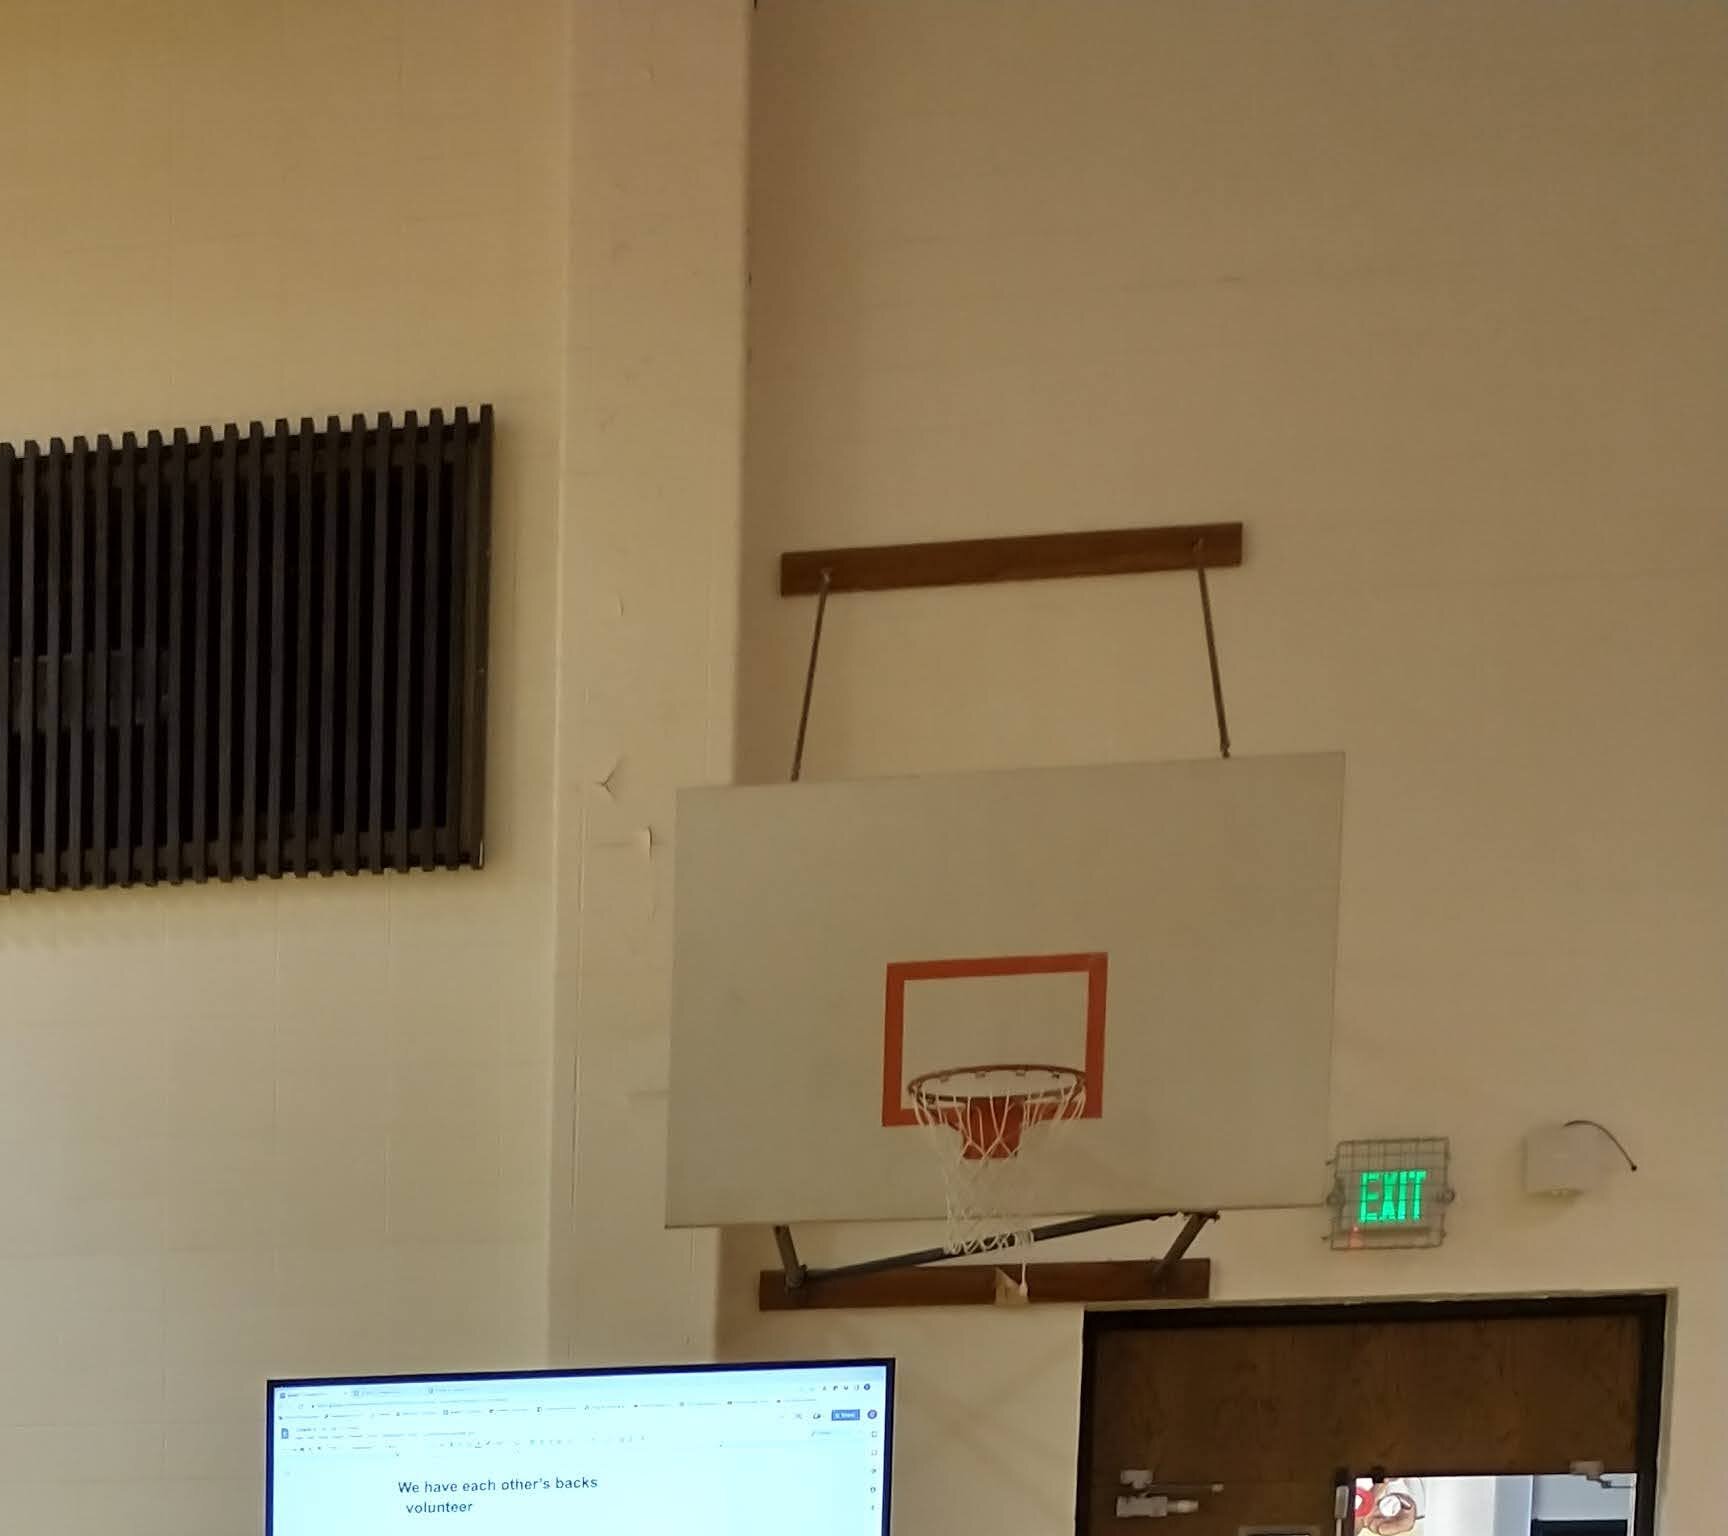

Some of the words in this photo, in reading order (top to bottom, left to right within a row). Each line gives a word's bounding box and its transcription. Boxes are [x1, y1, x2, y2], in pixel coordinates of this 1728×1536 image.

[1358, 1169, 1427, 1224] EXIT
[398, 1482, 419, 1493] We
[425, 1481, 457, 1493] have
[463, 1480, 495, 1491] each
[502, 1478, 550, 1490] other's
[556, 1477, 597, 1488] backs
[406, 1501, 472, 1513] volunteer
